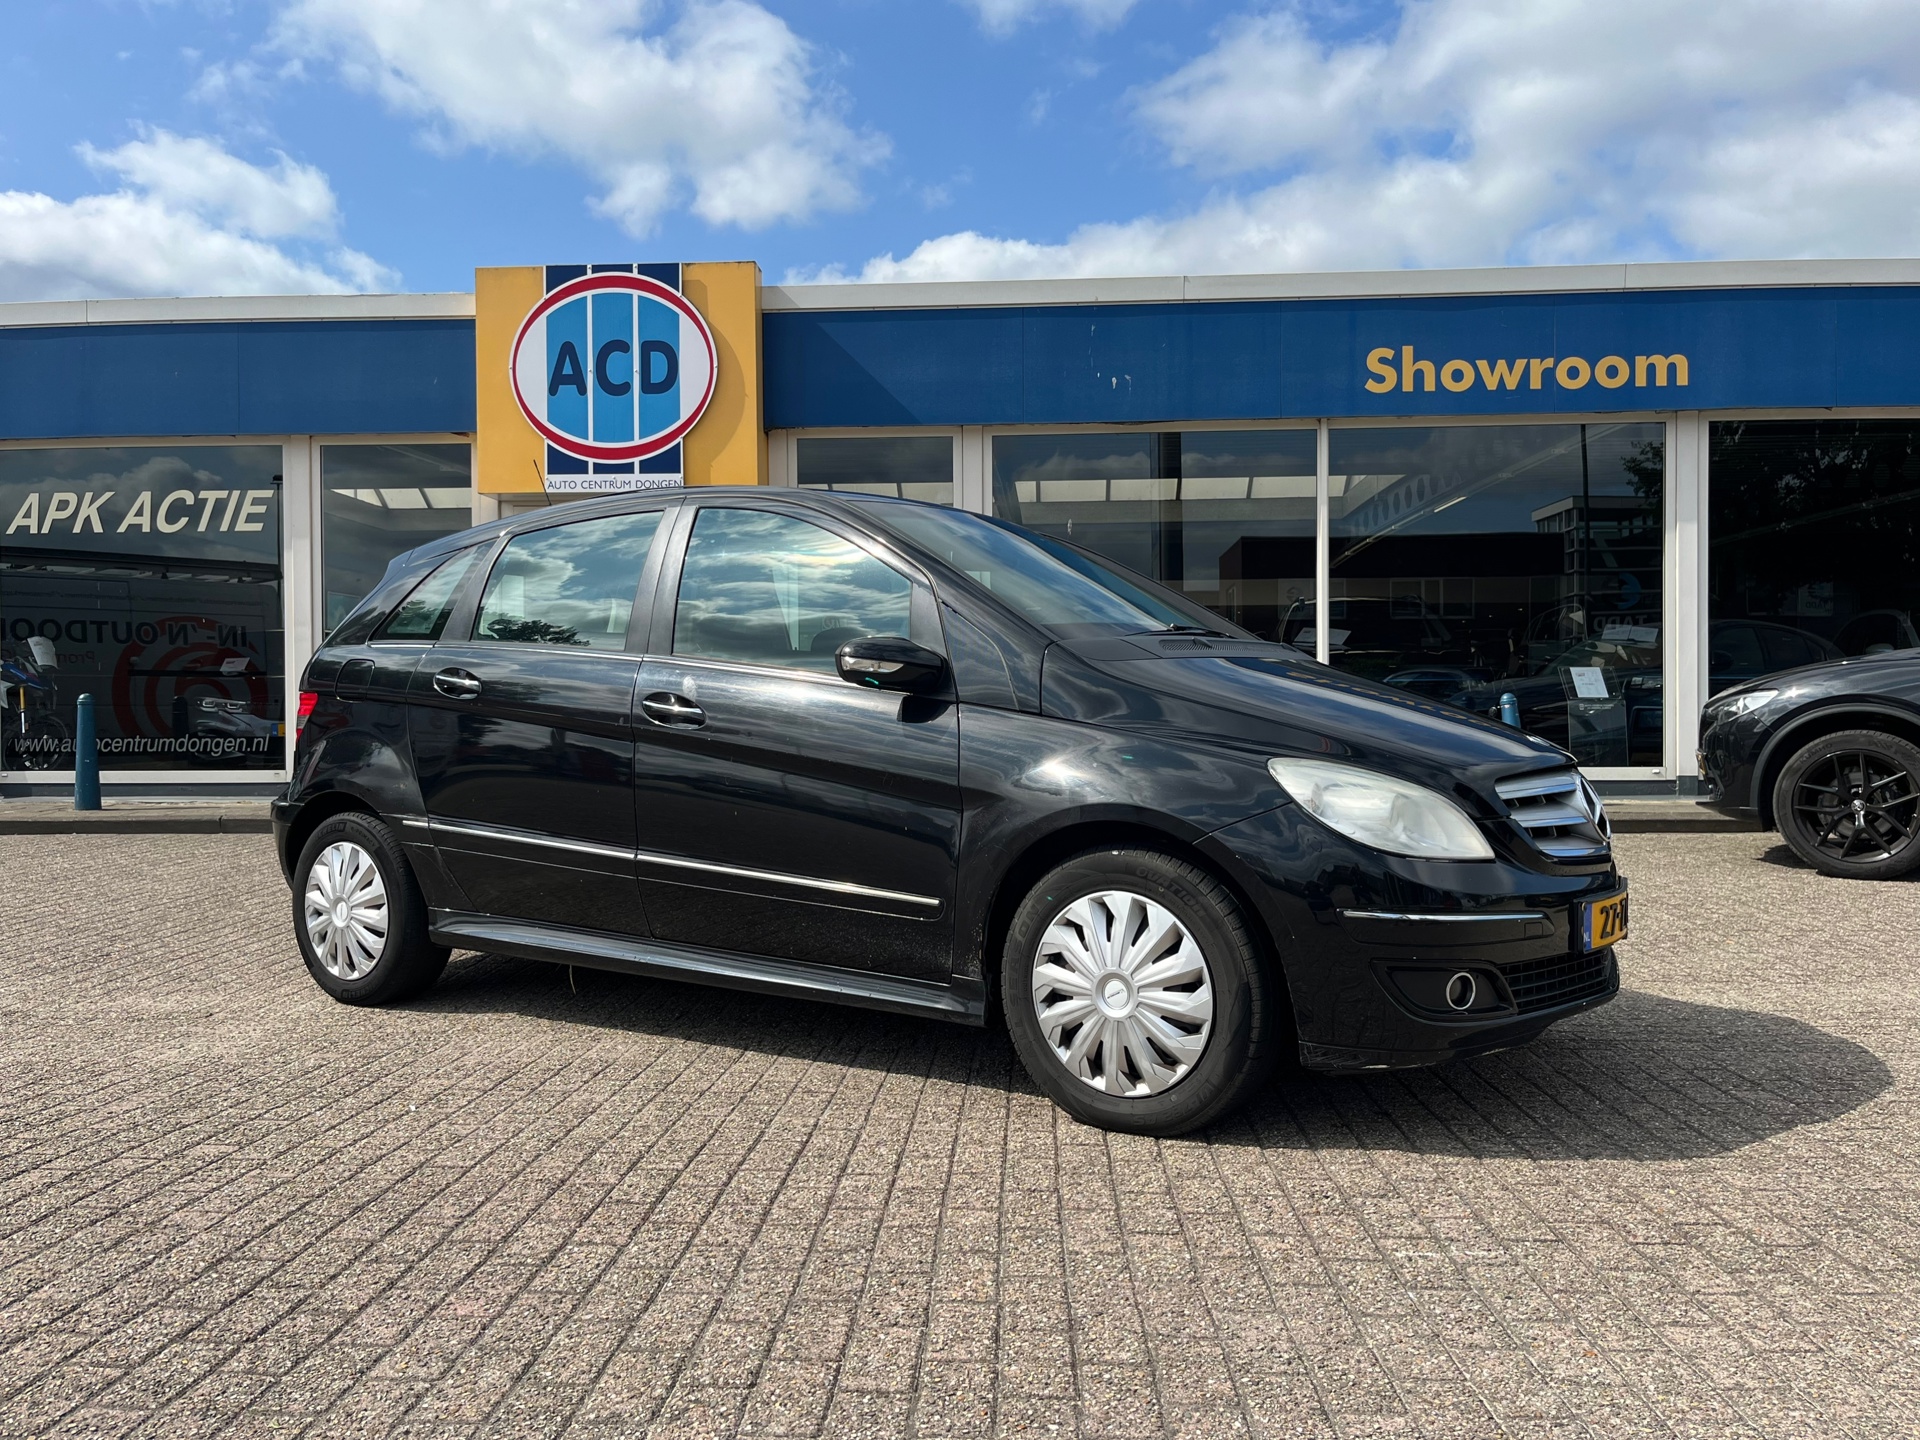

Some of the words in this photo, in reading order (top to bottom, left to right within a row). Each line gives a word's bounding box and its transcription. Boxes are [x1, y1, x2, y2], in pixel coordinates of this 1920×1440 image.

[548, 339, 679, 396] ACD
[1364, 345, 1689, 394] Showroom
[547, 480, 578, 490] AUTO
[580, 479, 632, 490] CENTRUM
[635, 479, 683, 489] DONGEN
[5, 491, 115, 535] APK
[117, 489, 274, 533] ACTIE
[14, 734, 270, 757] www.acentrumdongen.nl
[1799, 743, 1834, 765] KUMHO
